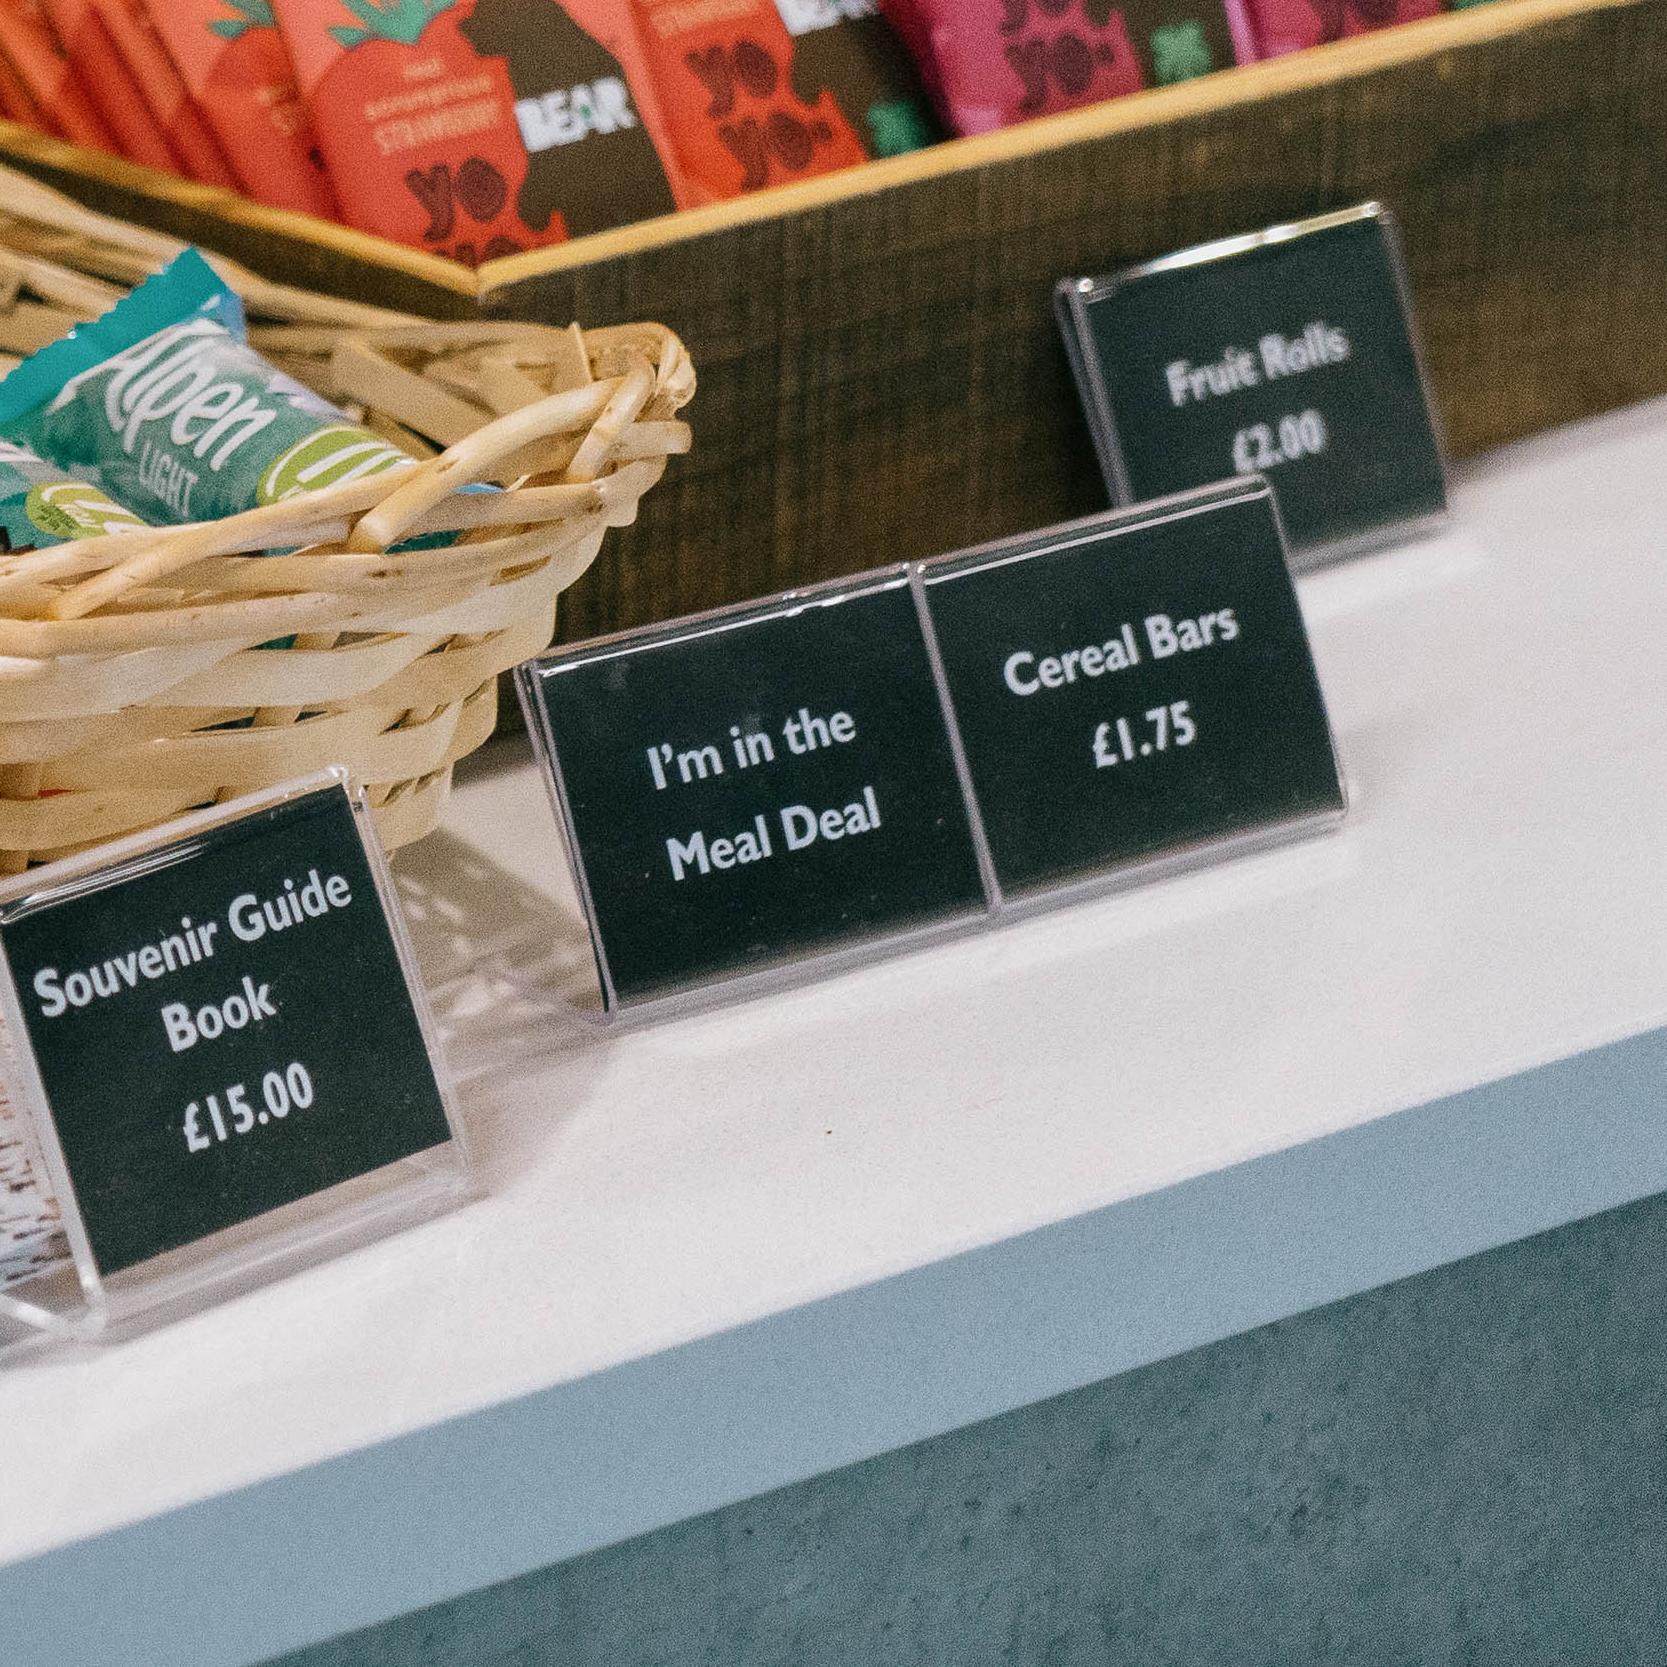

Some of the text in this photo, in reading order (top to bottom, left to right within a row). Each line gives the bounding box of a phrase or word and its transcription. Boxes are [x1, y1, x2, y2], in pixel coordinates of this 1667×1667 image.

[516, 78, 635, 152] BEAR
[45, 318, 276, 471] Alpen
[1167, 320, 1351, 406] Fruit Rolls
[139, 441, 199, 518] LIGHT
[1003, 606, 1241, 696] Cereal Bars
[647, 707, 856, 790] I'm in the
[1092, 700, 1196, 768] £1.75
[666, 787, 880, 881] Meal Deal
[33, 869, 352, 1018] Souvenir Guide
[161, 976, 276, 1051] Book
[182, 1062, 312, 1153] £15.00
